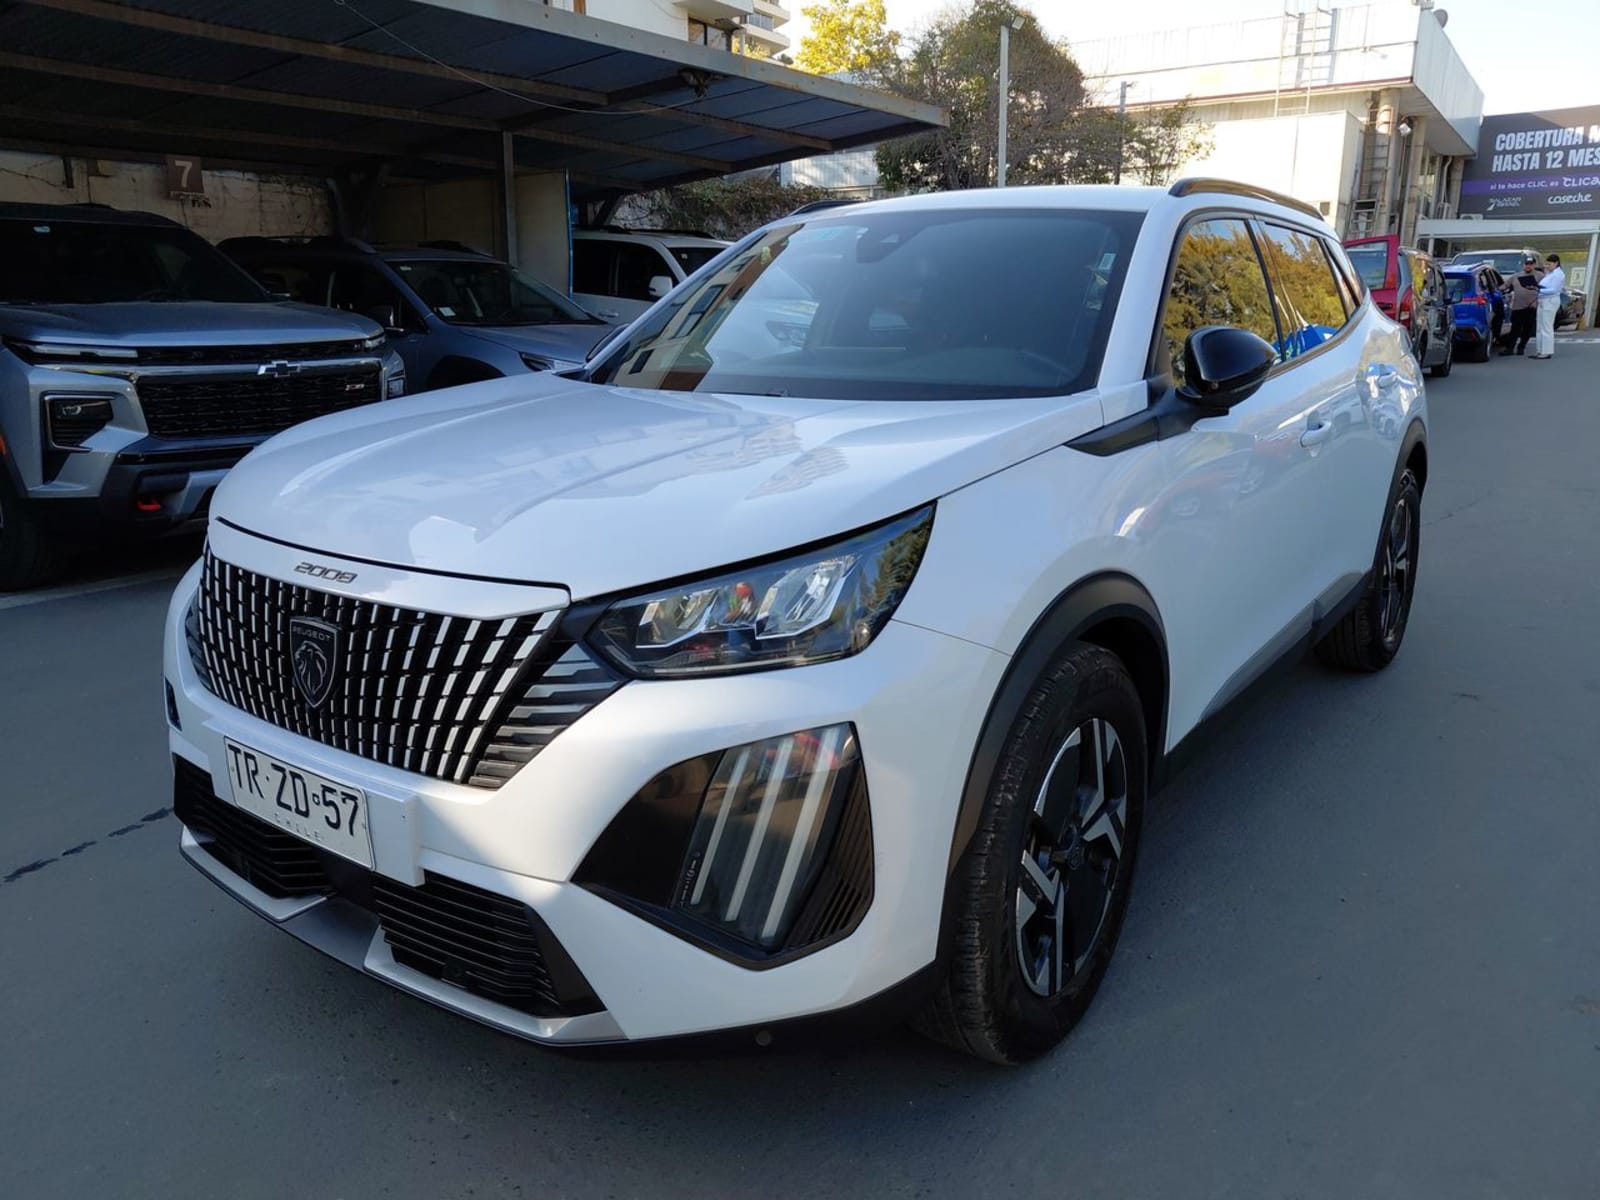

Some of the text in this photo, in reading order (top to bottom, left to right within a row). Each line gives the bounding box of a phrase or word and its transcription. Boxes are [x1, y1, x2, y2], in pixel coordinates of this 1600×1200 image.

[1495, 127, 1584, 151] COBERTURA
[1492, 153, 1540, 172] HASTA
[1545, 151, 1564, 169] 12
[175, 160, 192, 188] 7
[1507, 181, 1525, 189] hace
[294, 561, 358, 584] 2008
[292, 625, 331, 641] PEUGEOT
